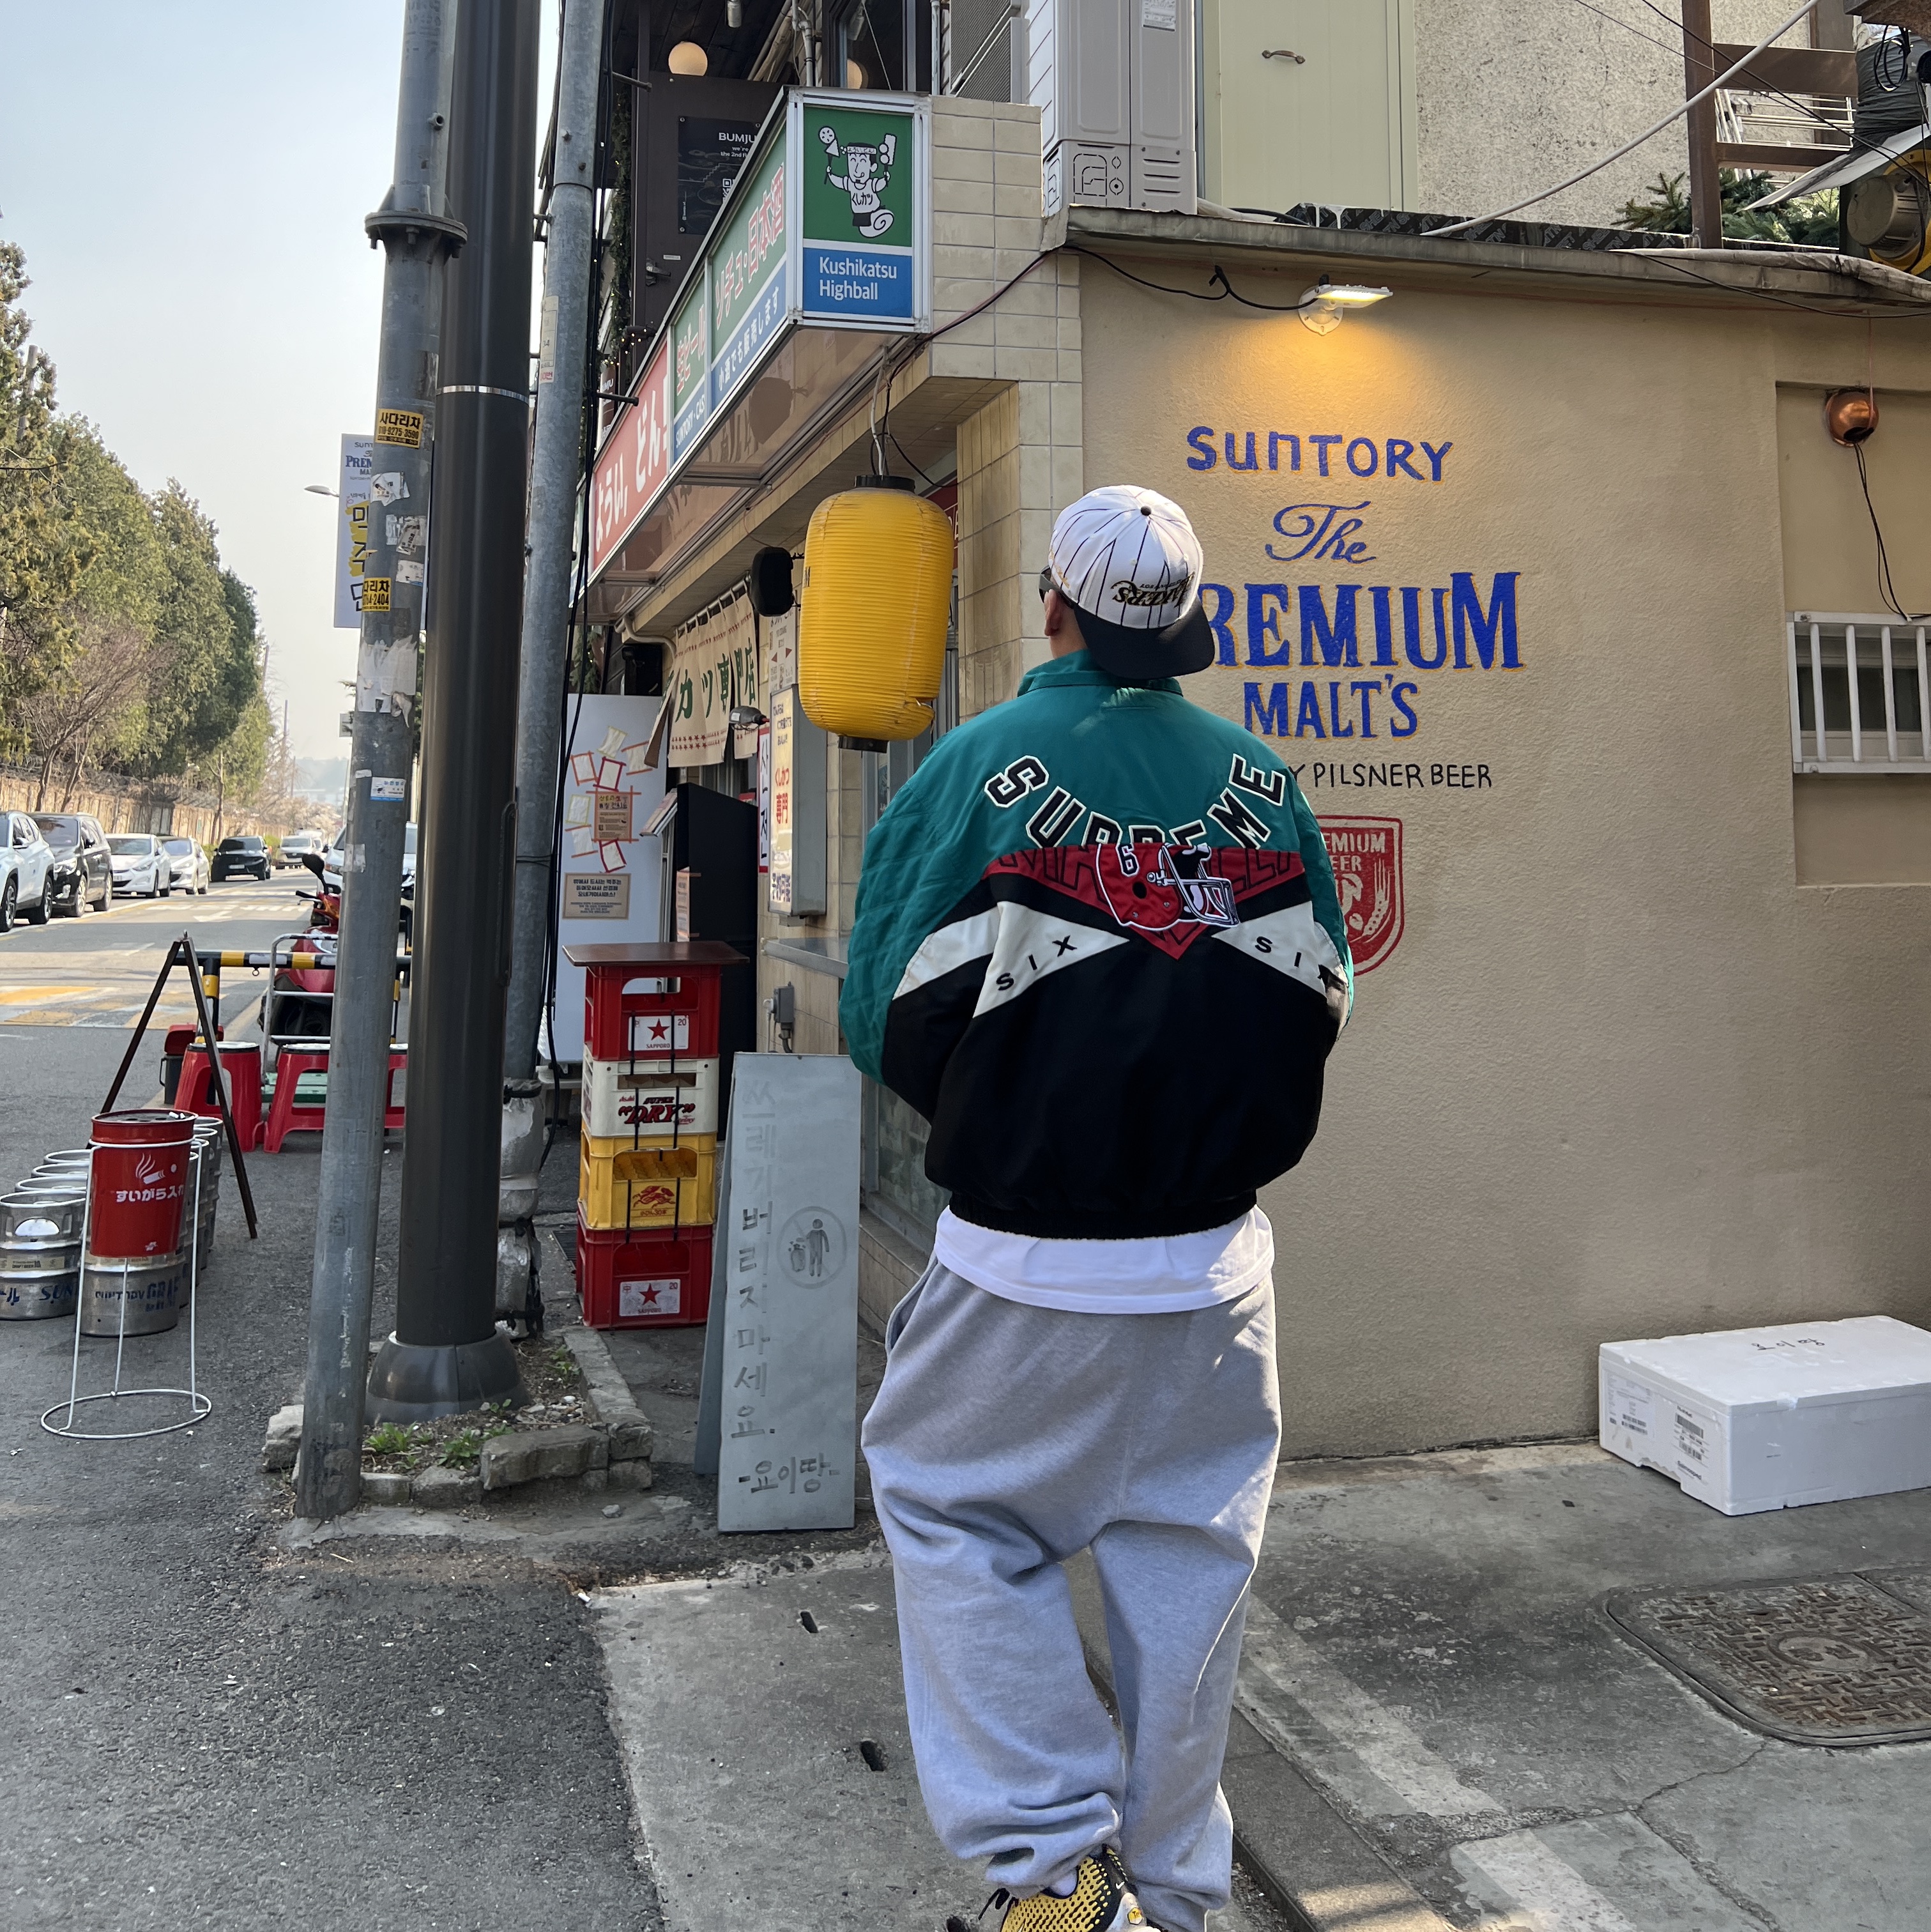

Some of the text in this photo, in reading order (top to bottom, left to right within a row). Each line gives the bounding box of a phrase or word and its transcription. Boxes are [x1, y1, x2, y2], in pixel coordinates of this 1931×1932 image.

[819, 256, 897, 280] Kushikatsu
[820, 280, 878, 301] Highball
[1265, 501, 1377, 564] The
[363, 580, 390, 592] 다리차
[1198, 572, 1527, 672] REMIUM
[1243, 673, 1421, 740] MALT'S
[1313, 763, 1424, 789] PILSNER
[1431, 763, 1492, 790] BEER
[1324, 832, 1385, 854] EMIUM
[1117, 843, 1140, 877] 6
[1331, 855, 1362, 871] EER
[996, 934, 1078, 992] SIX
